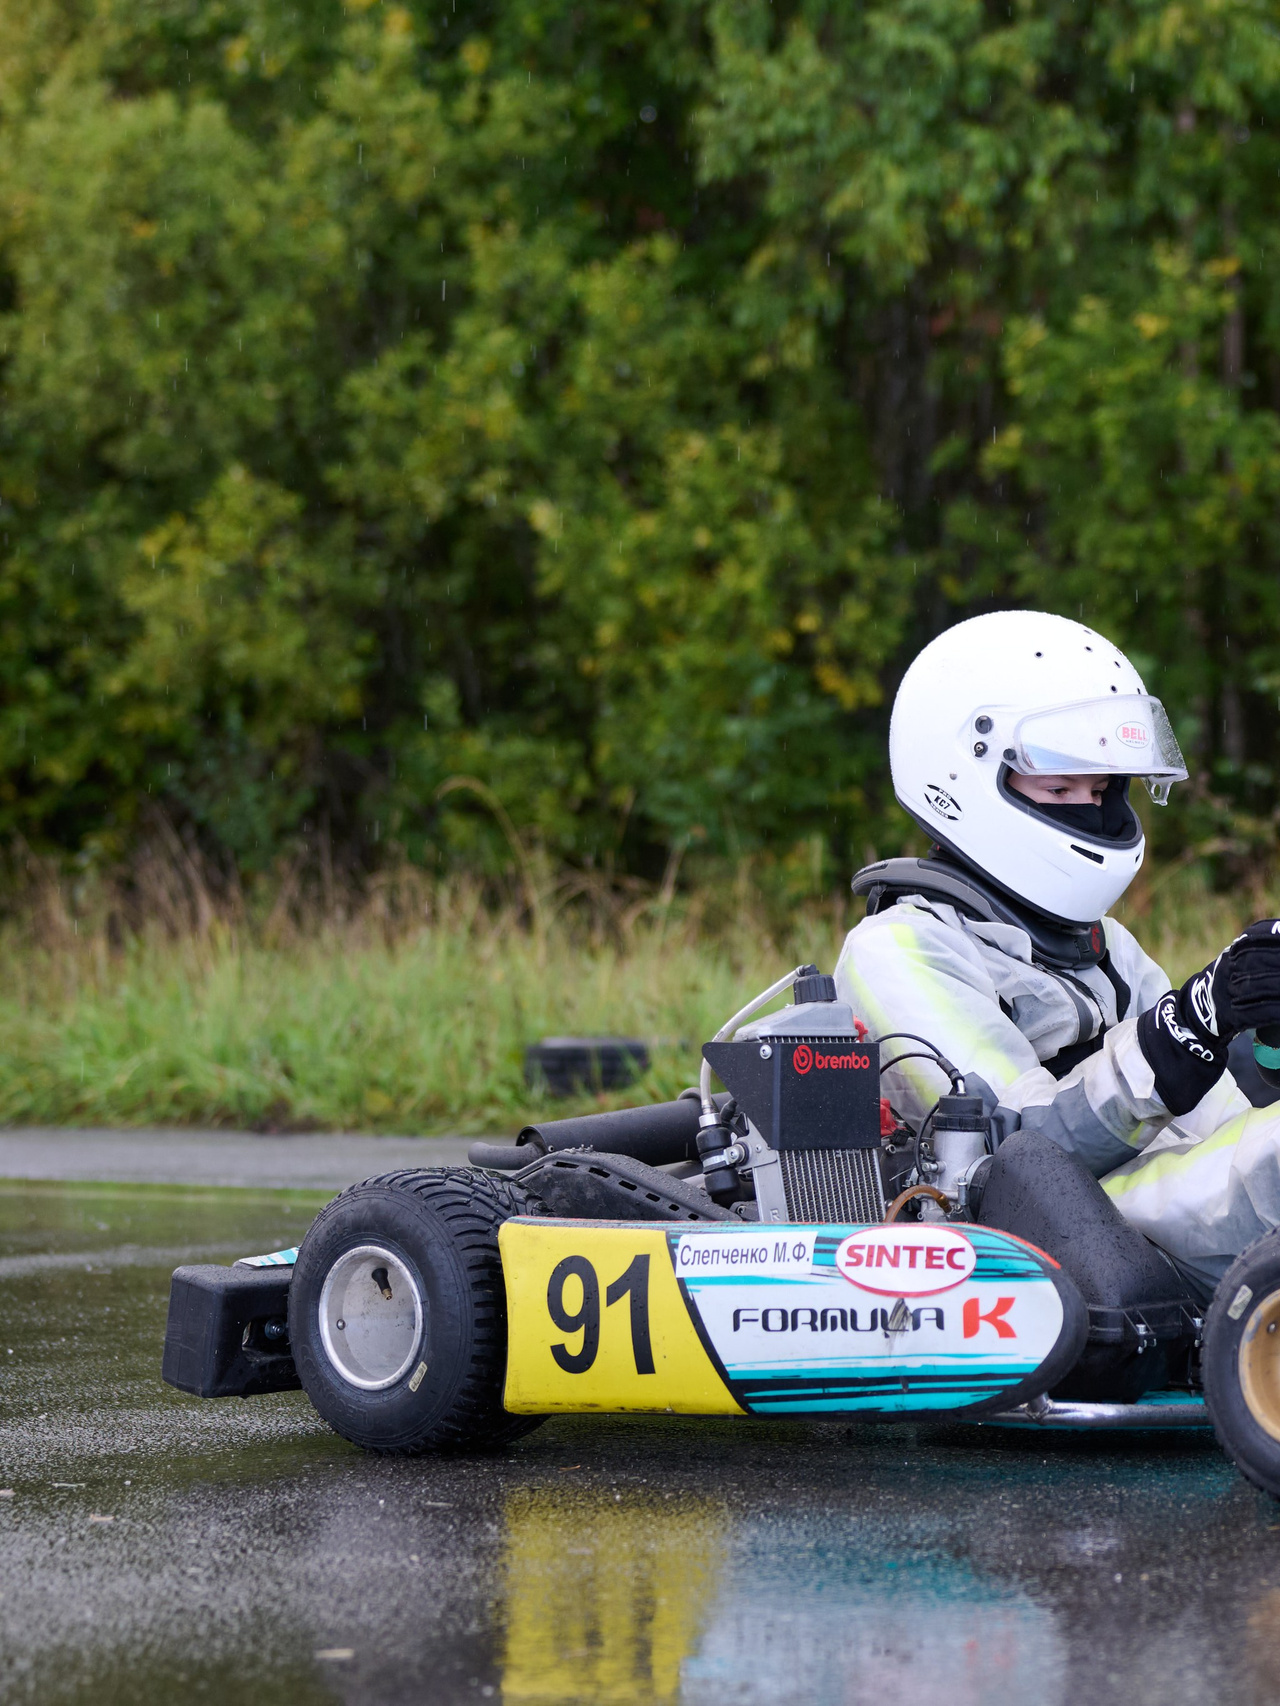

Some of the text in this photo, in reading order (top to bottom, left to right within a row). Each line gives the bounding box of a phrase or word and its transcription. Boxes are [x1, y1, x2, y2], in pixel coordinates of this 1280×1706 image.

[1121, 726, 1147, 742] BELL
[933, 795, 951, 810] KC7
[815, 1050, 870, 1070] brembo
[680, 1241, 810, 1266] Слепченко М.Ф.
[845, 1244, 966, 1271] SINTEC
[547, 1254, 656, 1375] 91
[732, 1297, 1018, 1339] FORMULA K
